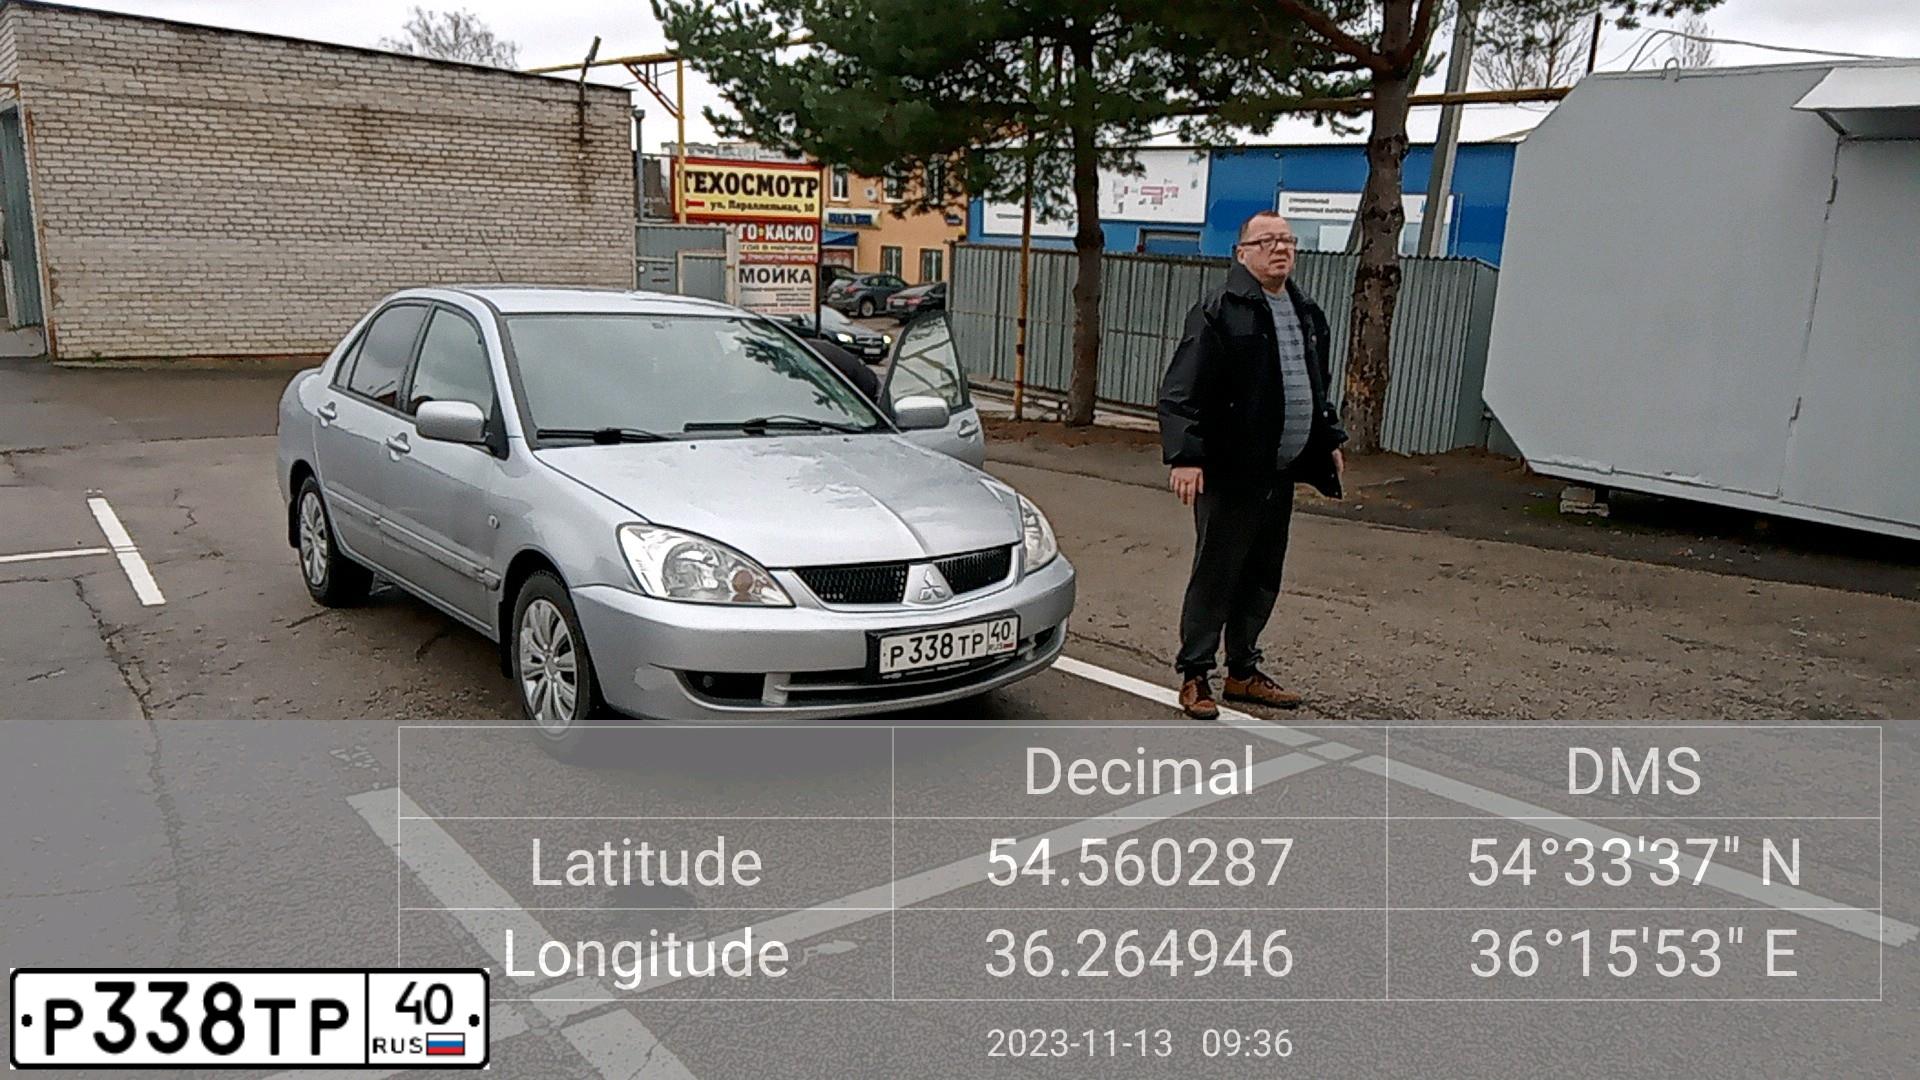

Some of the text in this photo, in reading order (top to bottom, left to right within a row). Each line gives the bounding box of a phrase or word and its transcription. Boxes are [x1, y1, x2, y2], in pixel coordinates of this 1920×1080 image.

[682, 170, 819, 198] ТЕХОСМОТР
[765, 223, 814, 241] КАСКО
[889, 620, 1011, 668] Р338ТР 40
